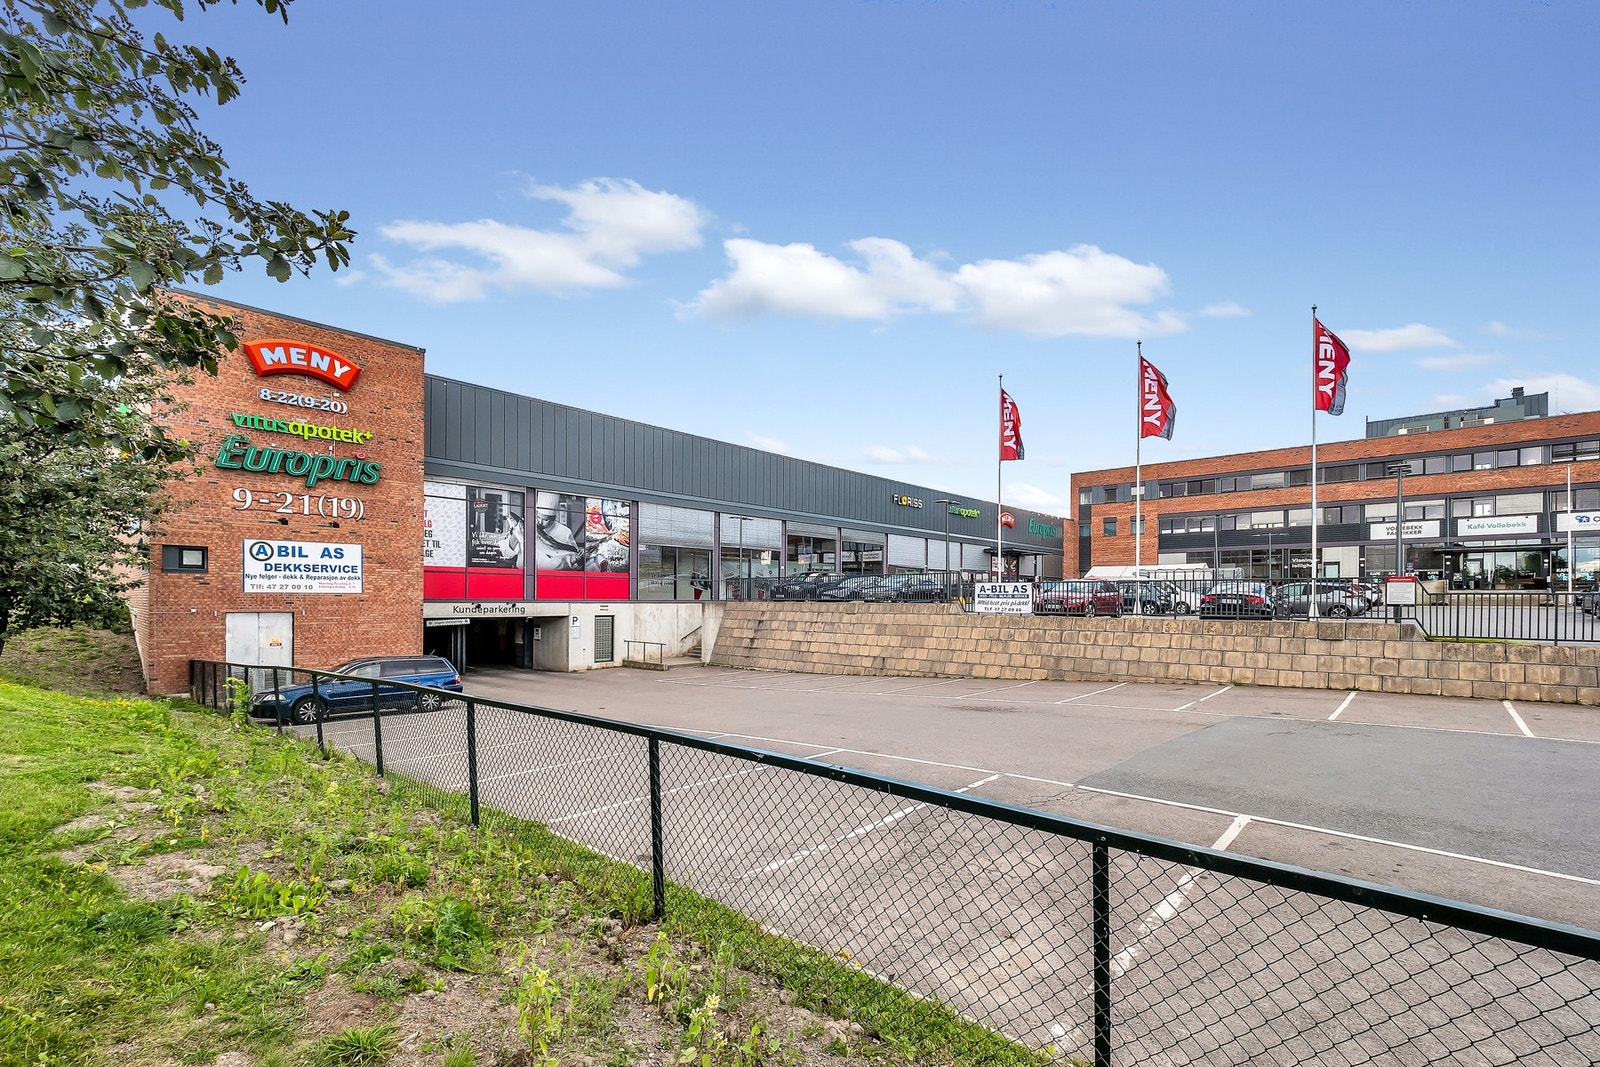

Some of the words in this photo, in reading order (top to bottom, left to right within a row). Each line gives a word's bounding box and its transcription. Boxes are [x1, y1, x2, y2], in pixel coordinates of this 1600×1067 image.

[260, 346, 351, 378] MENY
[260, 388, 348, 414] 8-22(9-20)
[216, 434, 382, 487] Europris
[893, 493, 923, 509] FLORISS
[1028, 516, 1057, 540] Europris
[1486, 520, 1526, 529] Vollebekk
[276, 545, 309, 558] BIL
[320, 546, 345, 560] AS
[264, 562, 359, 574] DEKKSERVICE
[979, 584, 1009, 594] A-BIL
[1012, 584, 1028, 594] AS
[452, 604, 526, 614] Kundeparkering
[572, 616, 578, 626] P
